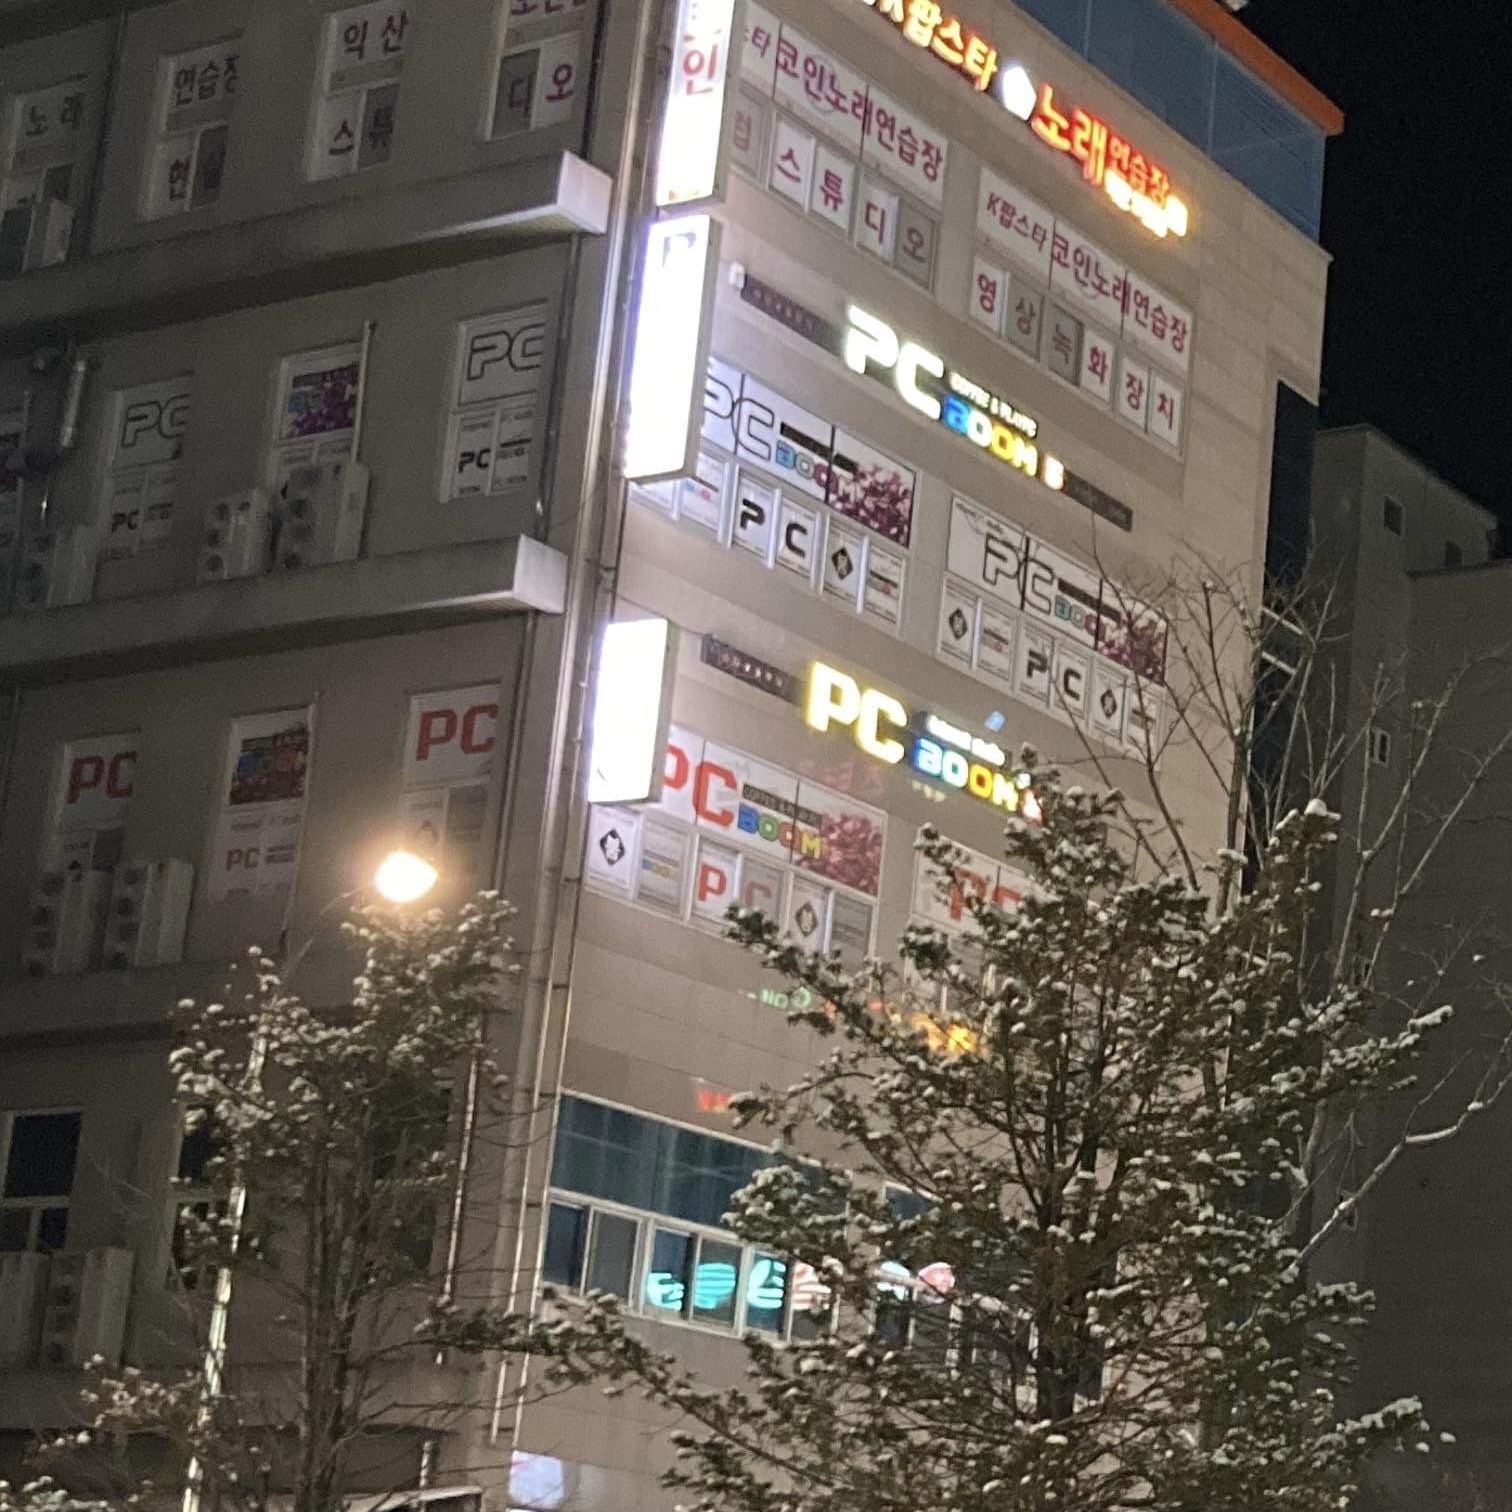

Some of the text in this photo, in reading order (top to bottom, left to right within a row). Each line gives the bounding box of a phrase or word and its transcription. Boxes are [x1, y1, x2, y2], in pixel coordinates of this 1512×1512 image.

[776, 34, 944, 182] 코인노래연습장
[1051, 232, 1188, 354] 코인노래연습장
[467, 322, 547, 381] PC
[845, 303, 945, 421] PC
[122, 393, 191, 448] PC
[416, 703, 499, 762] PC
[806, 660, 908, 765] PC
[67, 750, 138, 805] PC
[737, 801, 822, 861] BOOM
